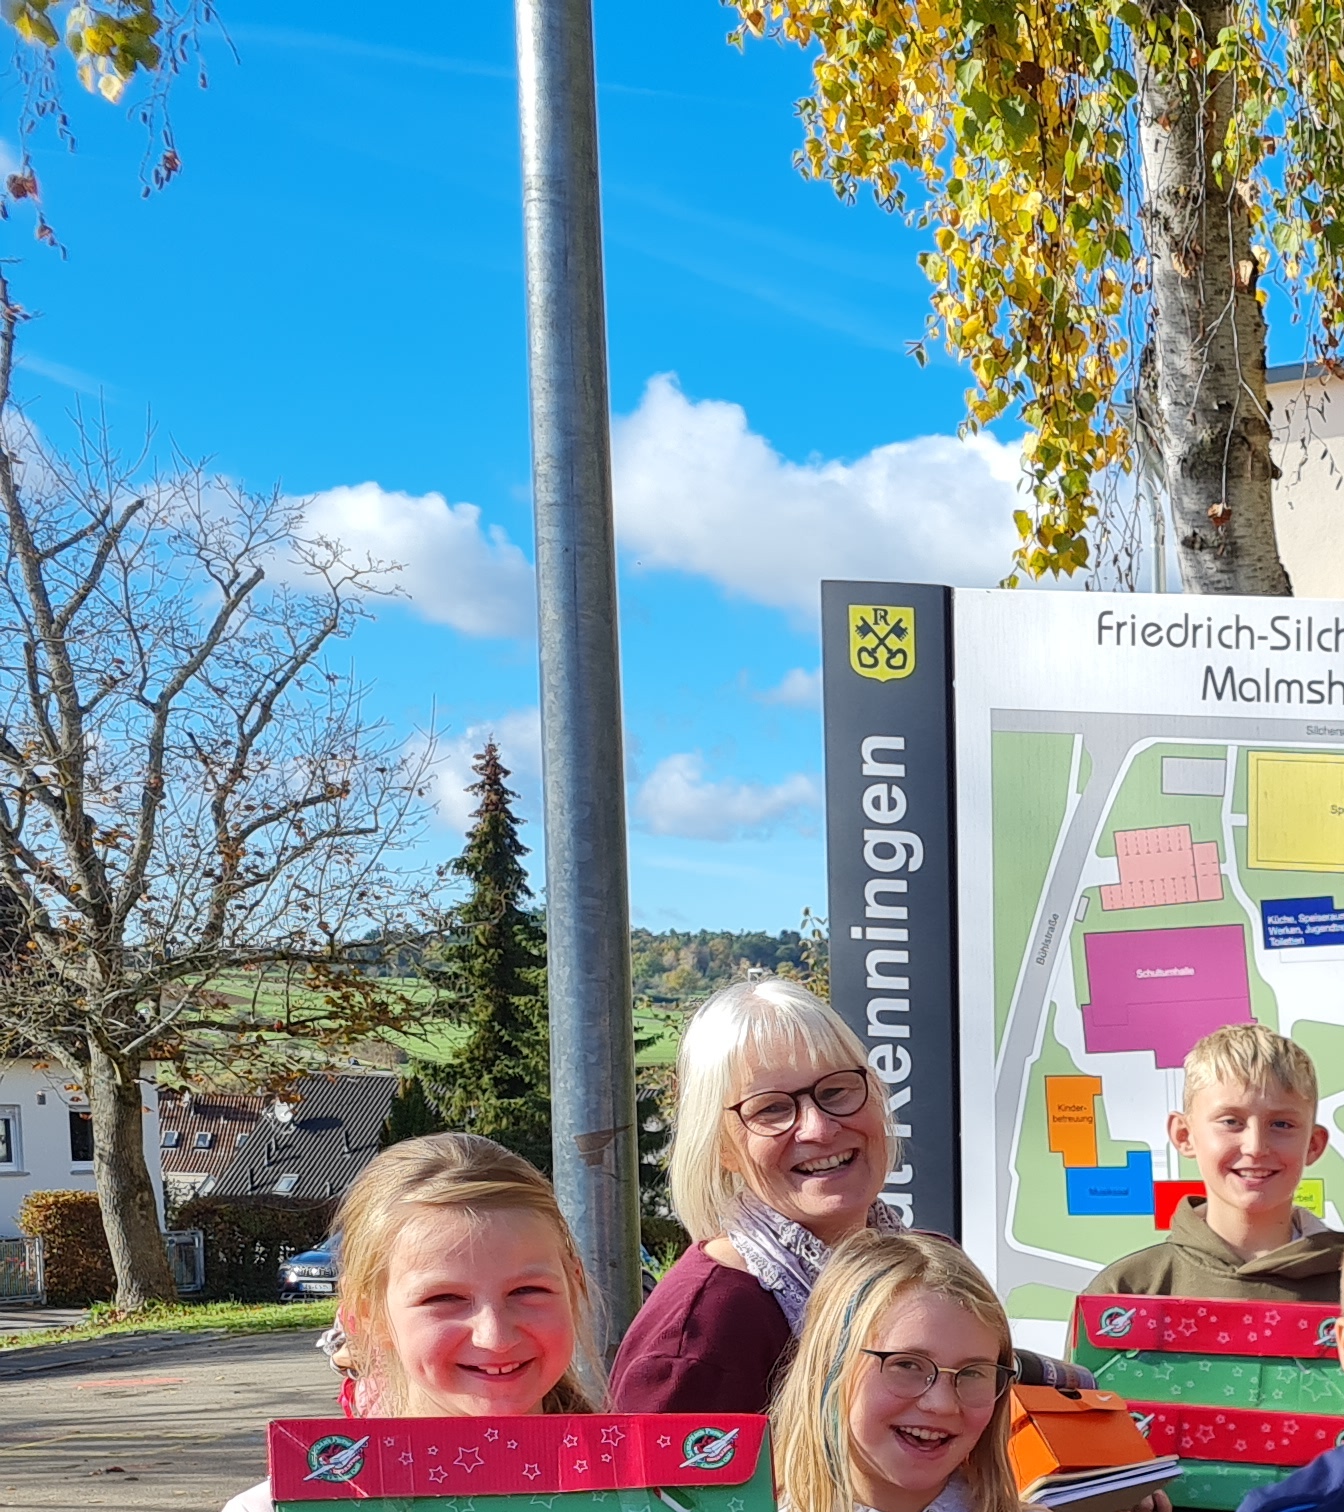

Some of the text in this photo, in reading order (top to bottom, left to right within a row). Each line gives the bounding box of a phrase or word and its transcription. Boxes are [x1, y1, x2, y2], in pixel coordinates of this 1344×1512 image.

[1035, 913, 1060, 966] Bühlstraße
[1057, 1103, 1088, 1112] Kinder-
[1052, 1114, 1094, 1125] betreuung
